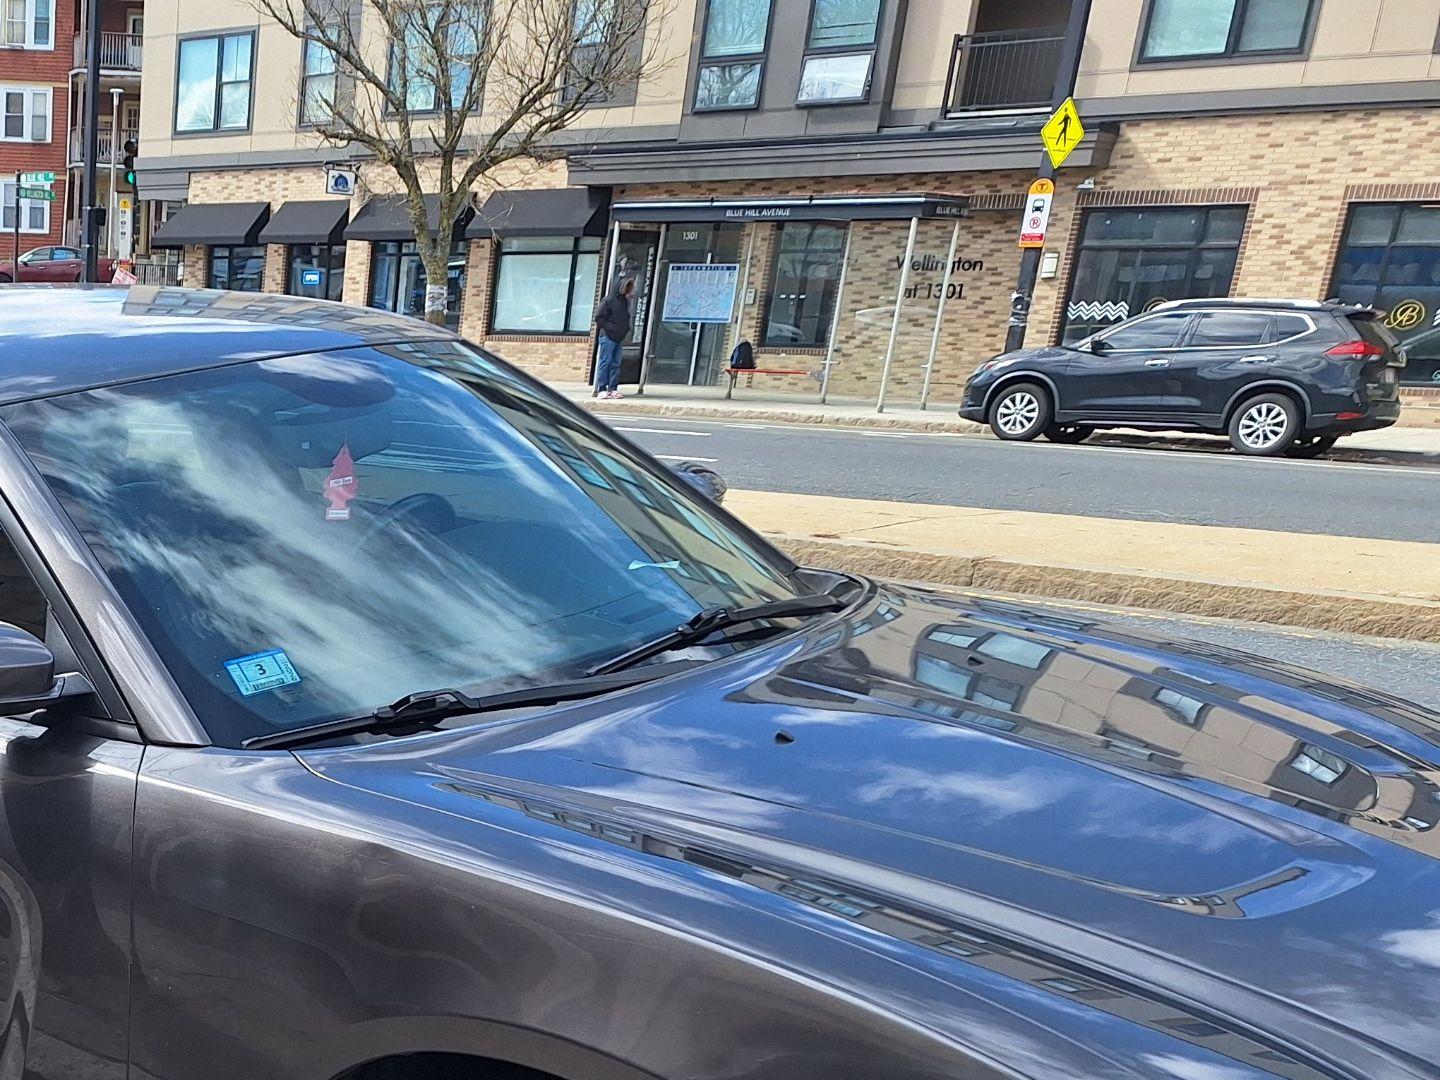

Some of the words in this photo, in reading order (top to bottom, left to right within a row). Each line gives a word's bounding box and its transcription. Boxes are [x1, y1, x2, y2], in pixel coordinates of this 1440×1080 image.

[725, 209, 743, 217] BLUE
[745, 209, 760, 217] HILL
[761, 207, 791, 216] AVENUE
[683, 231, 699, 240] 1301
[926, 283, 964, 299] 1301
[254, 663, 267, 676] 3
